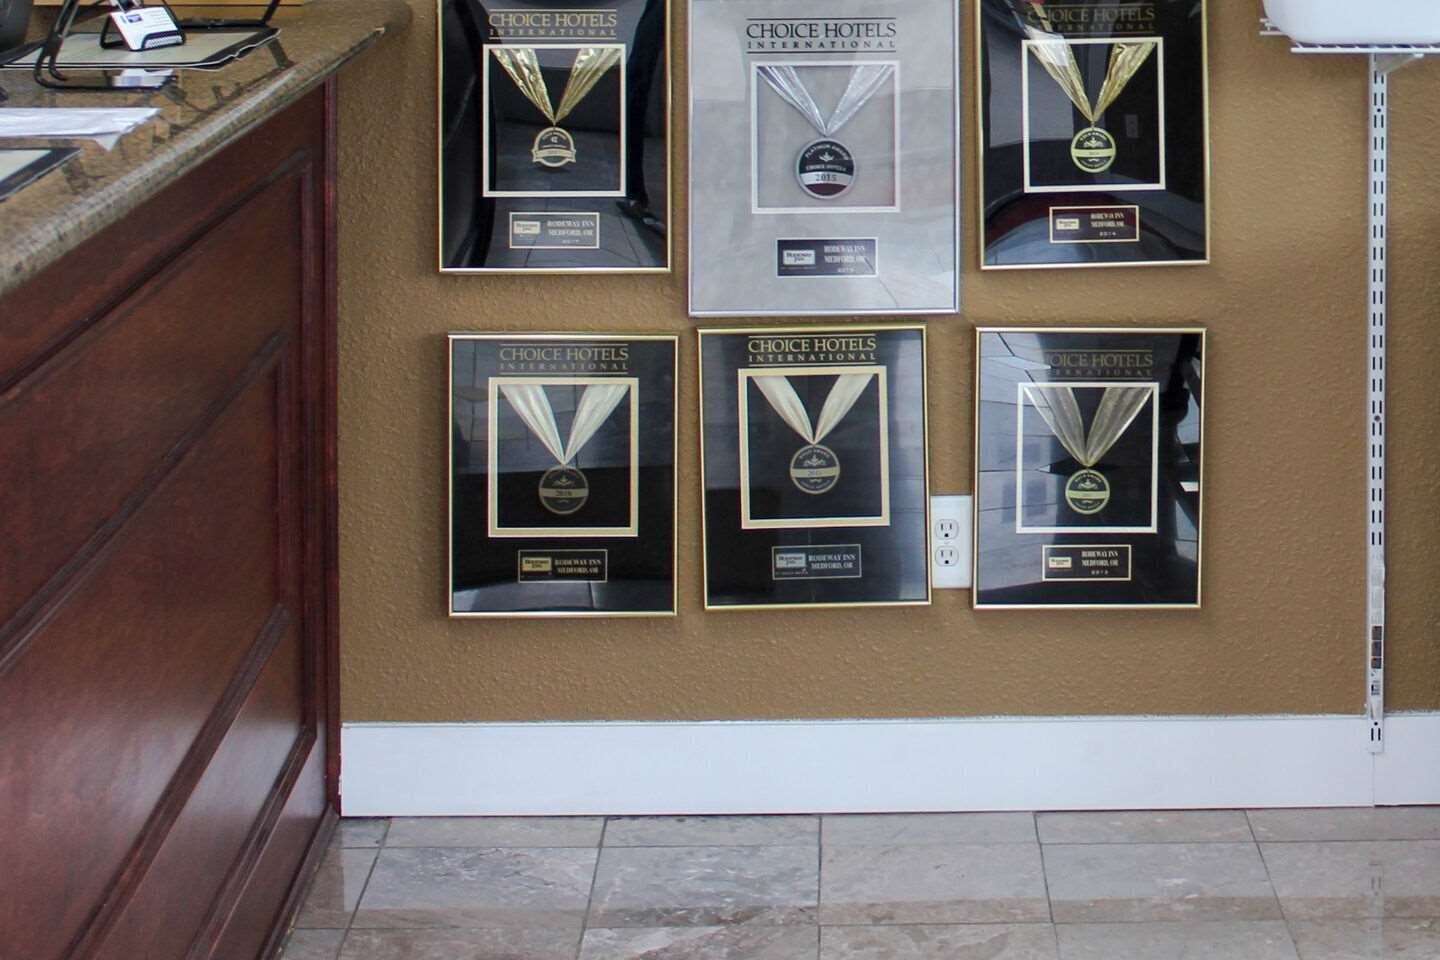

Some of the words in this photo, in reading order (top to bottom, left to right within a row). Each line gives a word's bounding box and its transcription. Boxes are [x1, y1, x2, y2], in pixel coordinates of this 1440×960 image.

[489, 12, 551, 28] CHOICE
[555, 12, 618, 28] HOTELS
[1093, 6, 1156, 22] HOTELS
[489, 28, 617, 36] INTERNATIONAL
[746, 23, 819, 39] CHOICE
[824, 22, 897, 38] HOTELS
[747, 41, 896, 49] INTERNATIONAL
[748, 340, 810, 354] CHOICE
[813, 338, 877, 352] HOTELS
[500, 347, 562, 361] CHOICE
[566, 347, 629, 361] HOTELS
[748, 353, 876, 363] INTERNATIONAL
[1049, 353, 1089, 369] OICE
[1091, 352, 1153, 367] HOTELS
[500, 362, 628, 371] INTERNATIONAL
